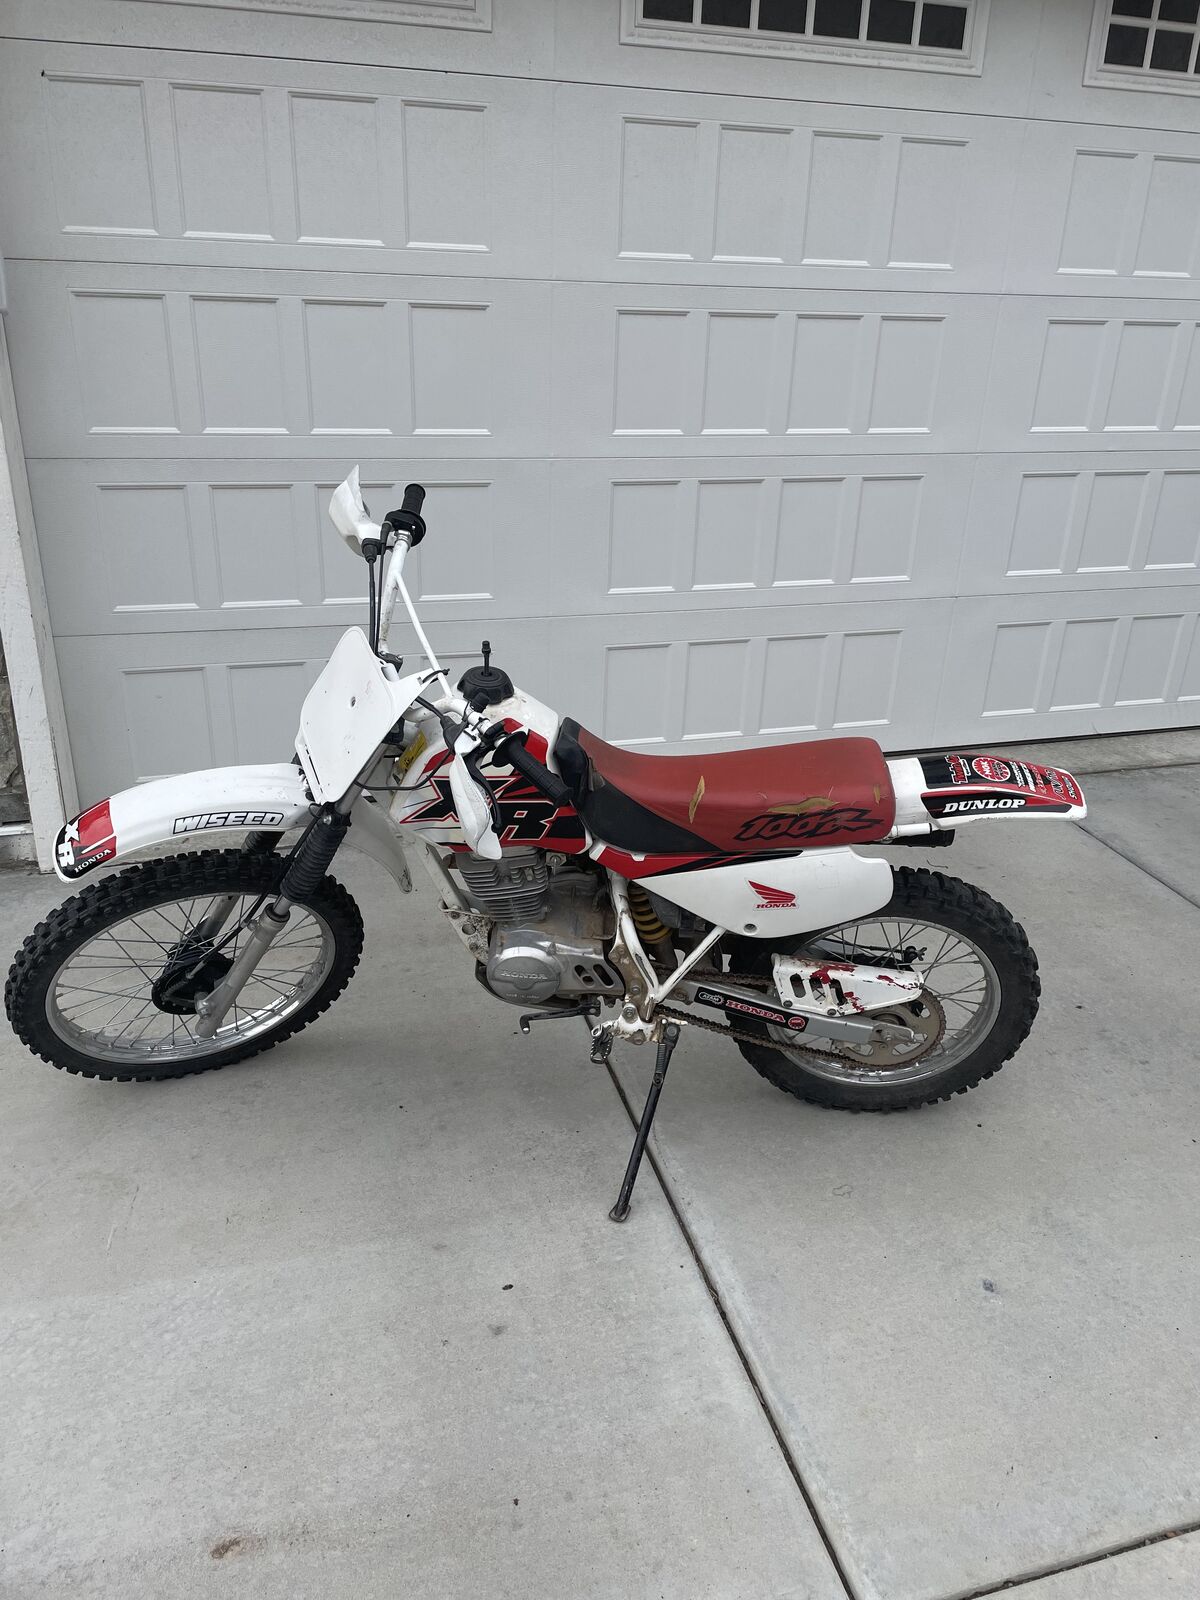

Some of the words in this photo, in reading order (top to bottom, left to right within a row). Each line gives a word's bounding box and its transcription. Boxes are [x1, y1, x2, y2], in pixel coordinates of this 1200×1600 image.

[943, 798, 1026, 814] DUNLOP
[172, 811, 285, 835] WISECO
[74, 848, 112, 873] HONDA
[500, 968, 549, 980] HONDA
[725, 999, 786, 1023] HONDA
